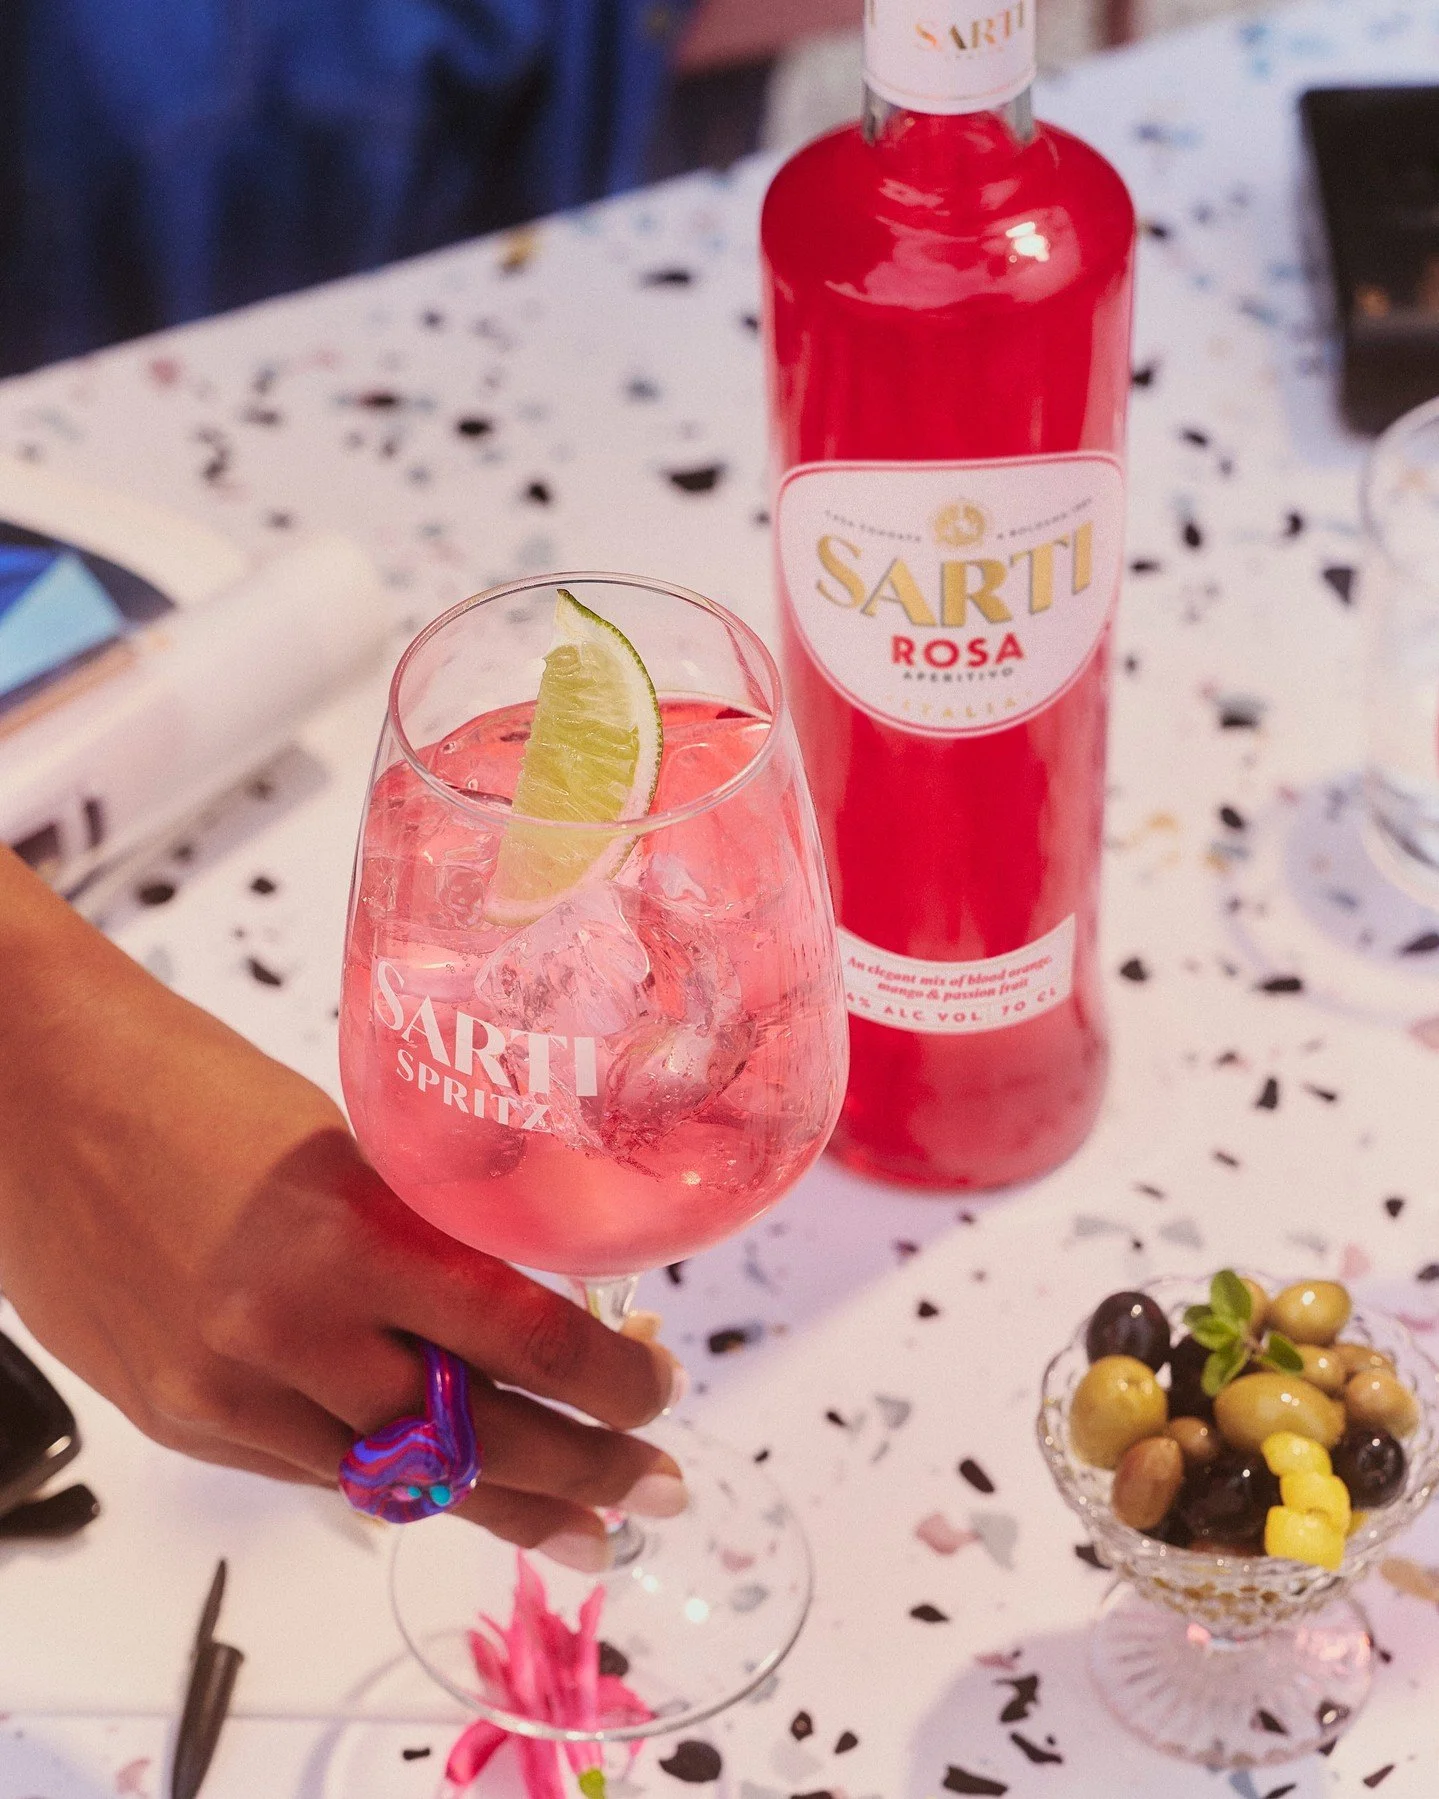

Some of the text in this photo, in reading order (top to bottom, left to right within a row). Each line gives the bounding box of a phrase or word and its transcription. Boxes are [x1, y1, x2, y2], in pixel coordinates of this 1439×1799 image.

[815, 519, 1094, 628] SARTI
[891, 632, 1026, 669] ROSA
[903, 666, 1013, 683] APERITIVO
[867, 965, 916, 983] elegant
[920, 976, 946, 986] mix
[949, 974, 965, 988] of
[968, 969, 1006, 985] blood
[877, 978, 1029, 1003] mango & passion fruit
[1002, 1001, 1026, 1016] 70
[1037, 986, 1056, 1003] CL
[373, 960, 598, 1096] SARTI
[396, 1048, 552, 1133] SPRITZ
